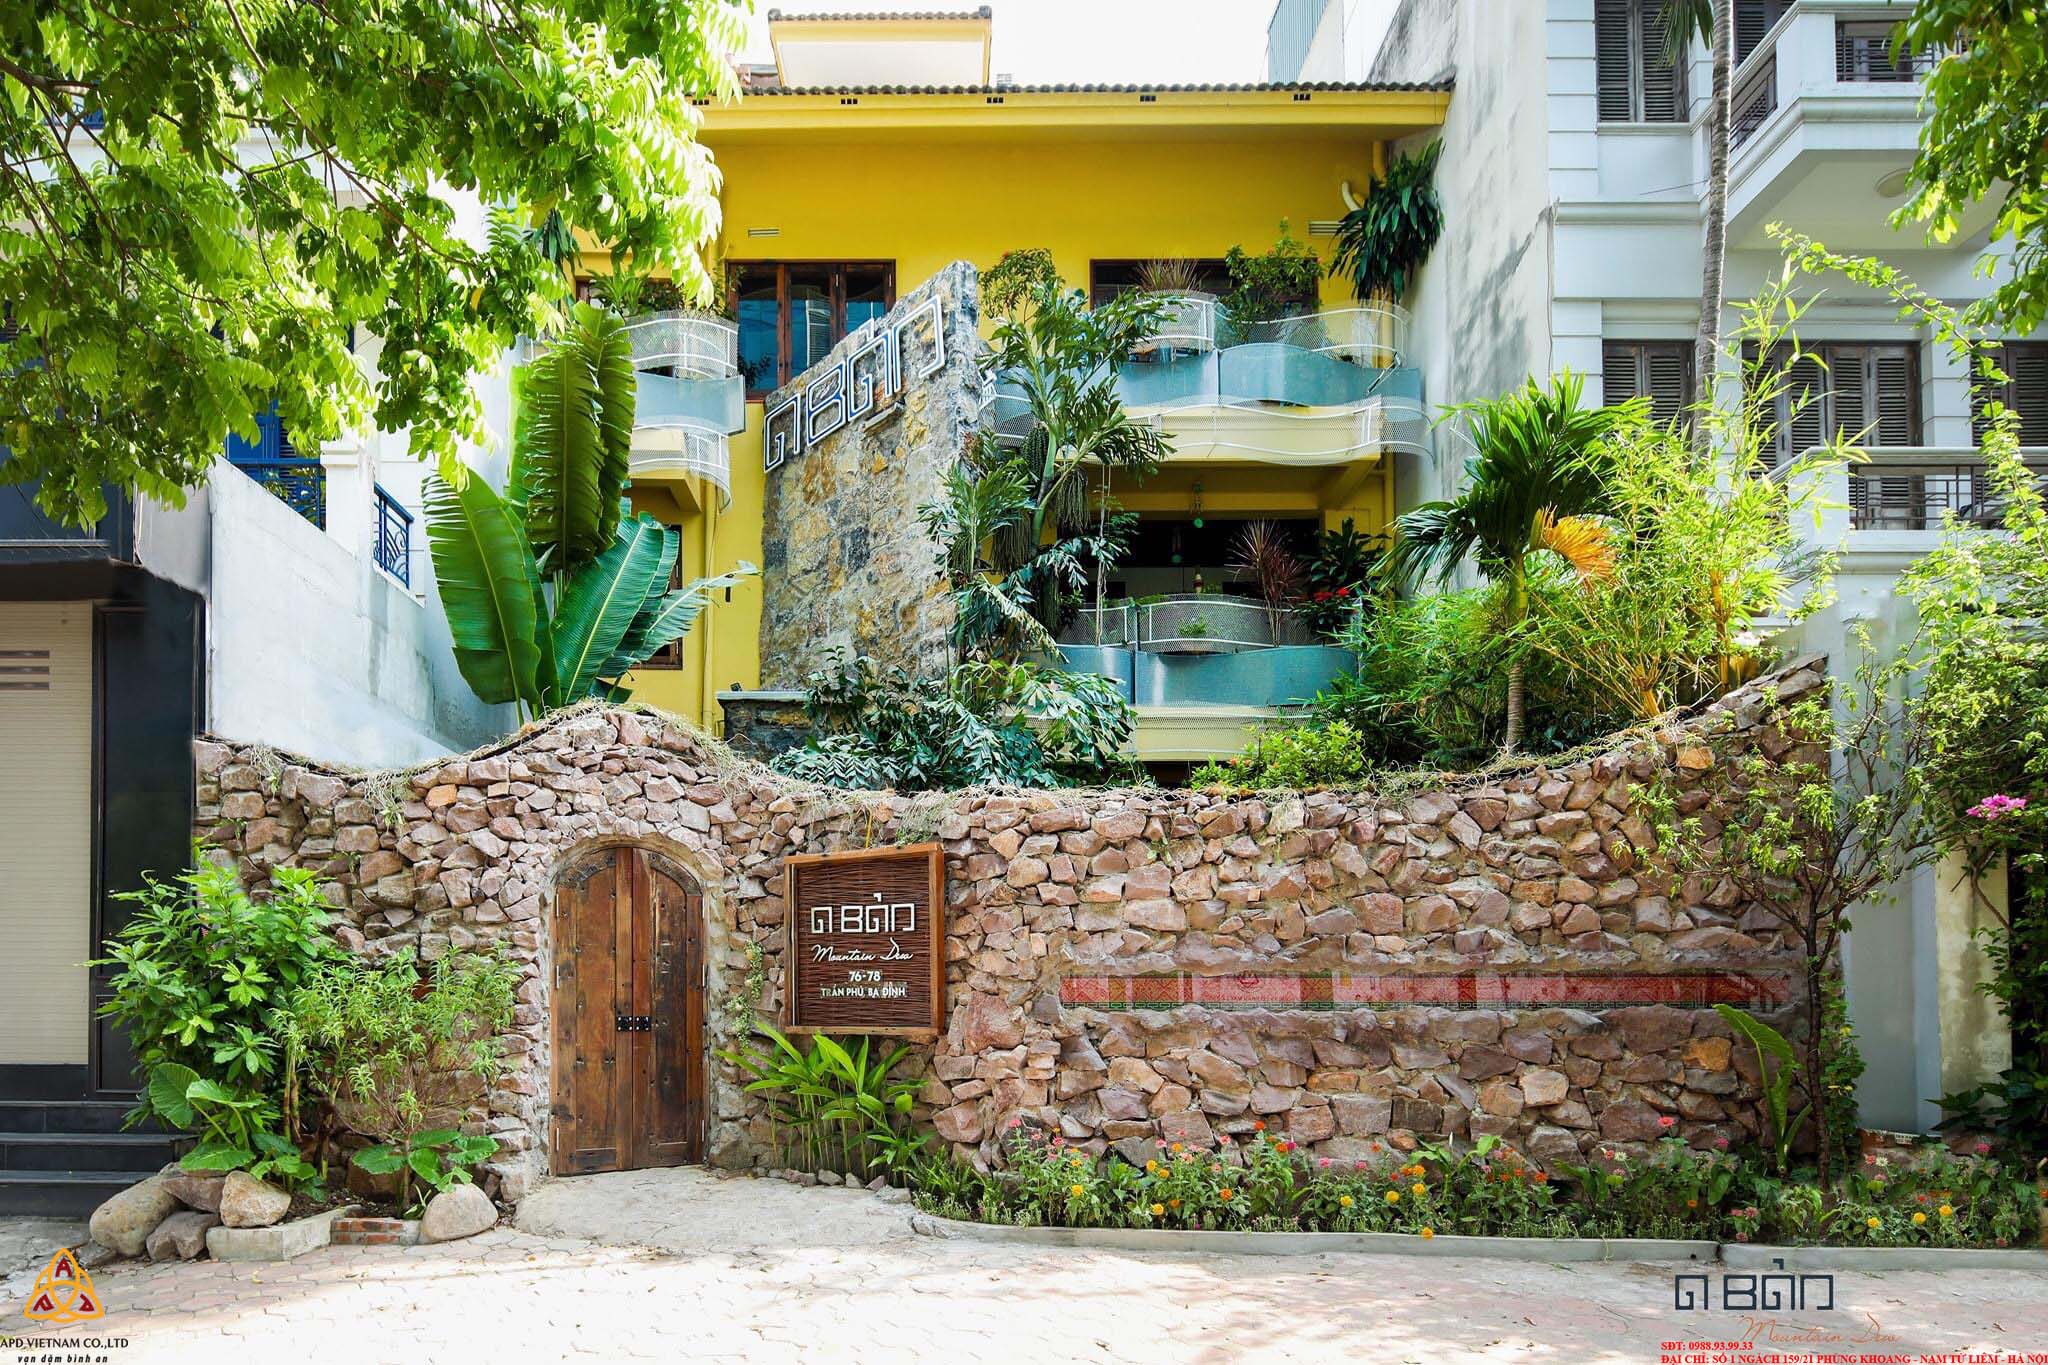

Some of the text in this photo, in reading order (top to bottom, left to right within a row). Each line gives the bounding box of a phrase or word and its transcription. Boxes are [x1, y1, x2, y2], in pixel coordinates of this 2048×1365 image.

[811, 937, 913, 962] Mountain Dew
[848, 970, 881, 982] 76-78
